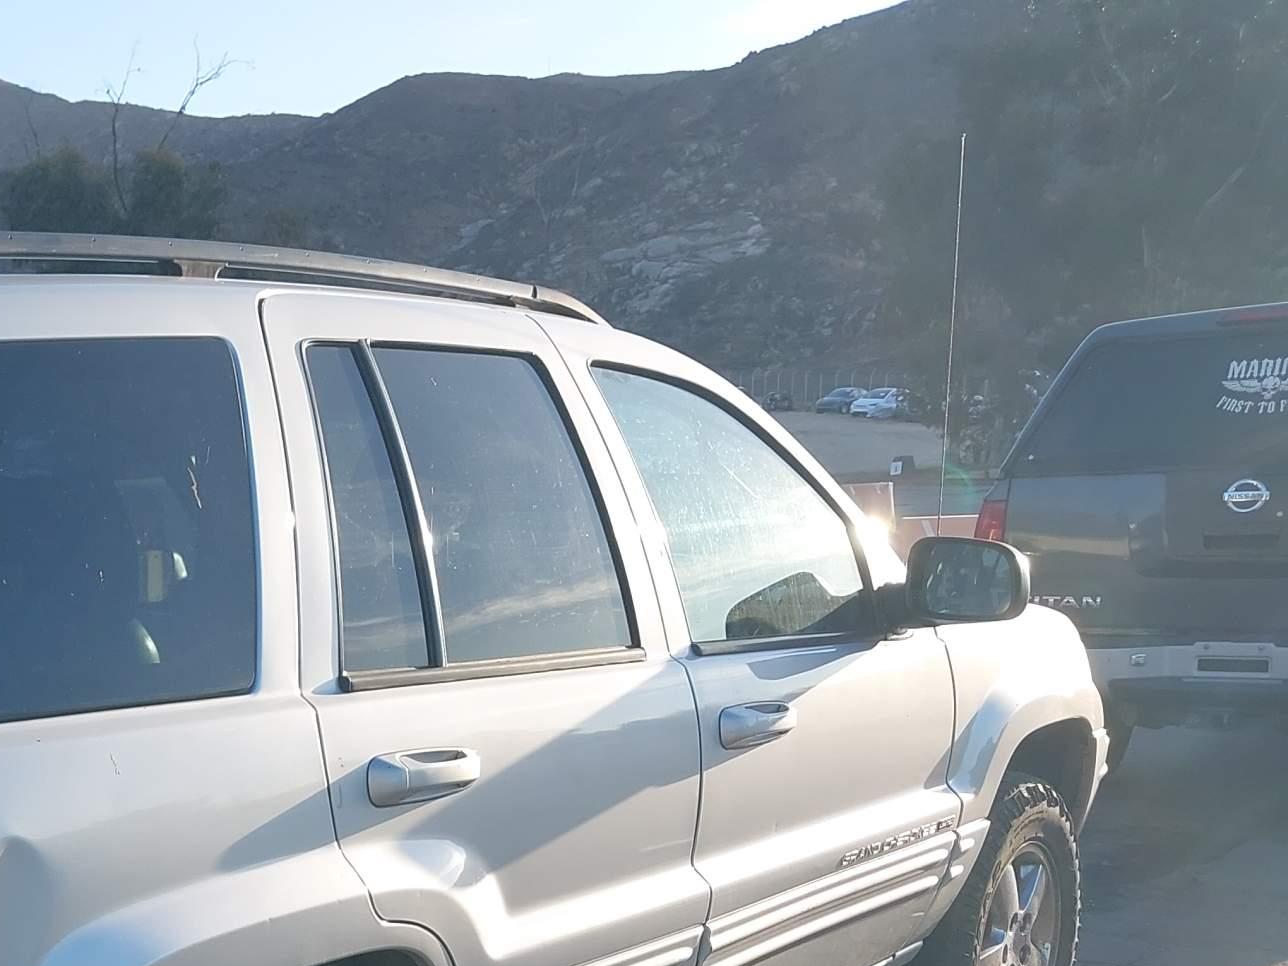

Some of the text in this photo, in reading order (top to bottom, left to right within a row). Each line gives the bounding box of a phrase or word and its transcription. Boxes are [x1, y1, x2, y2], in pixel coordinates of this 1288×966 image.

[1216, 395, 1254, 413] FIRST
[1258, 401, 1275, 414] TO
[1029, 596, 1101, 608] ITAN
